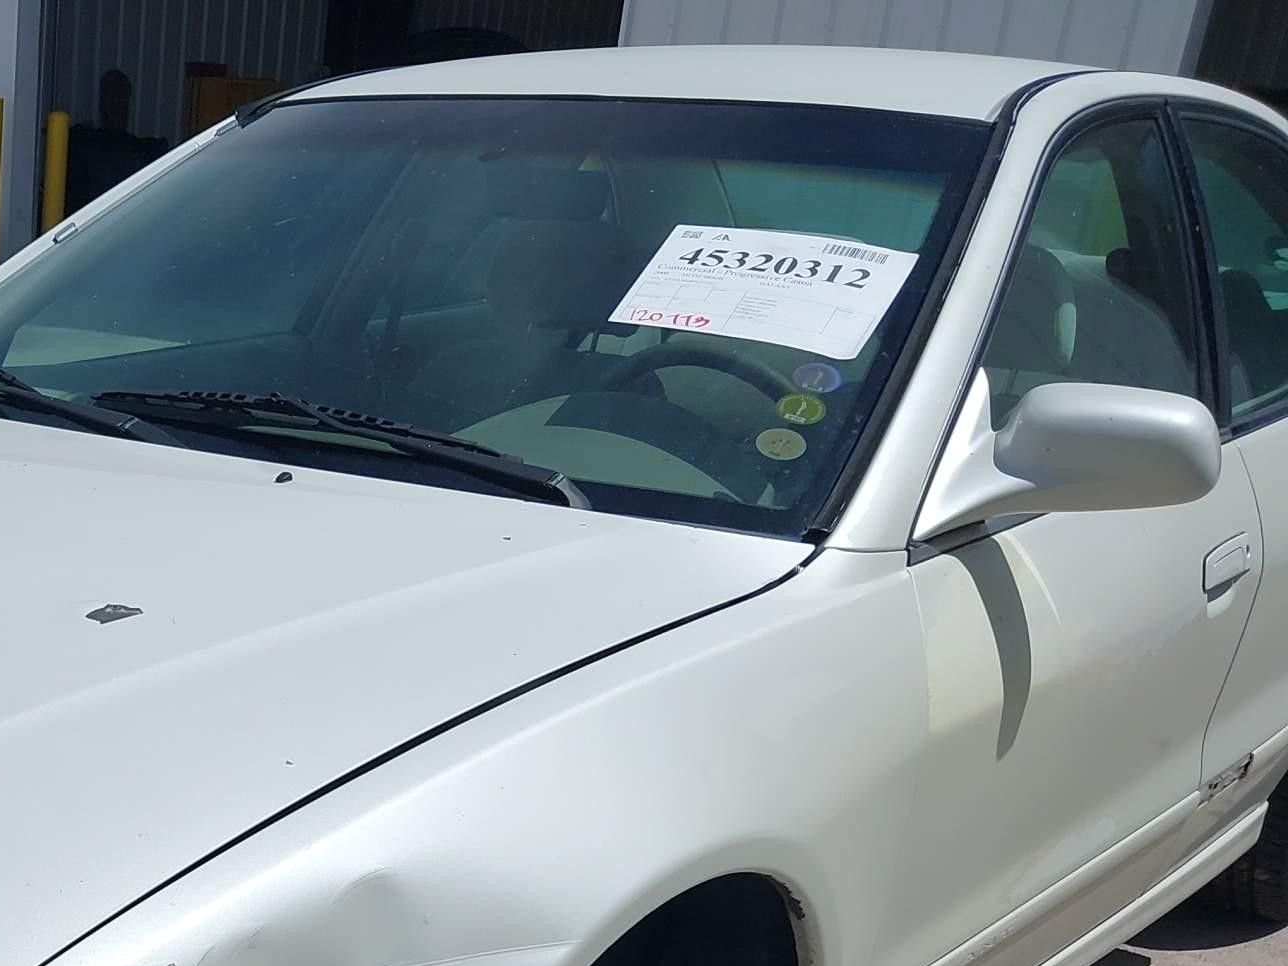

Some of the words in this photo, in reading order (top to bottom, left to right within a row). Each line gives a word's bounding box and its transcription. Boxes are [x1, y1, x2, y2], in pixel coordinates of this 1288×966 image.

[657, 263, 716, 275] Commercial
[725, 270, 781, 282] Progressive
[679, 247, 871, 289] 45320312
[629, 308, 664, 322] 120
